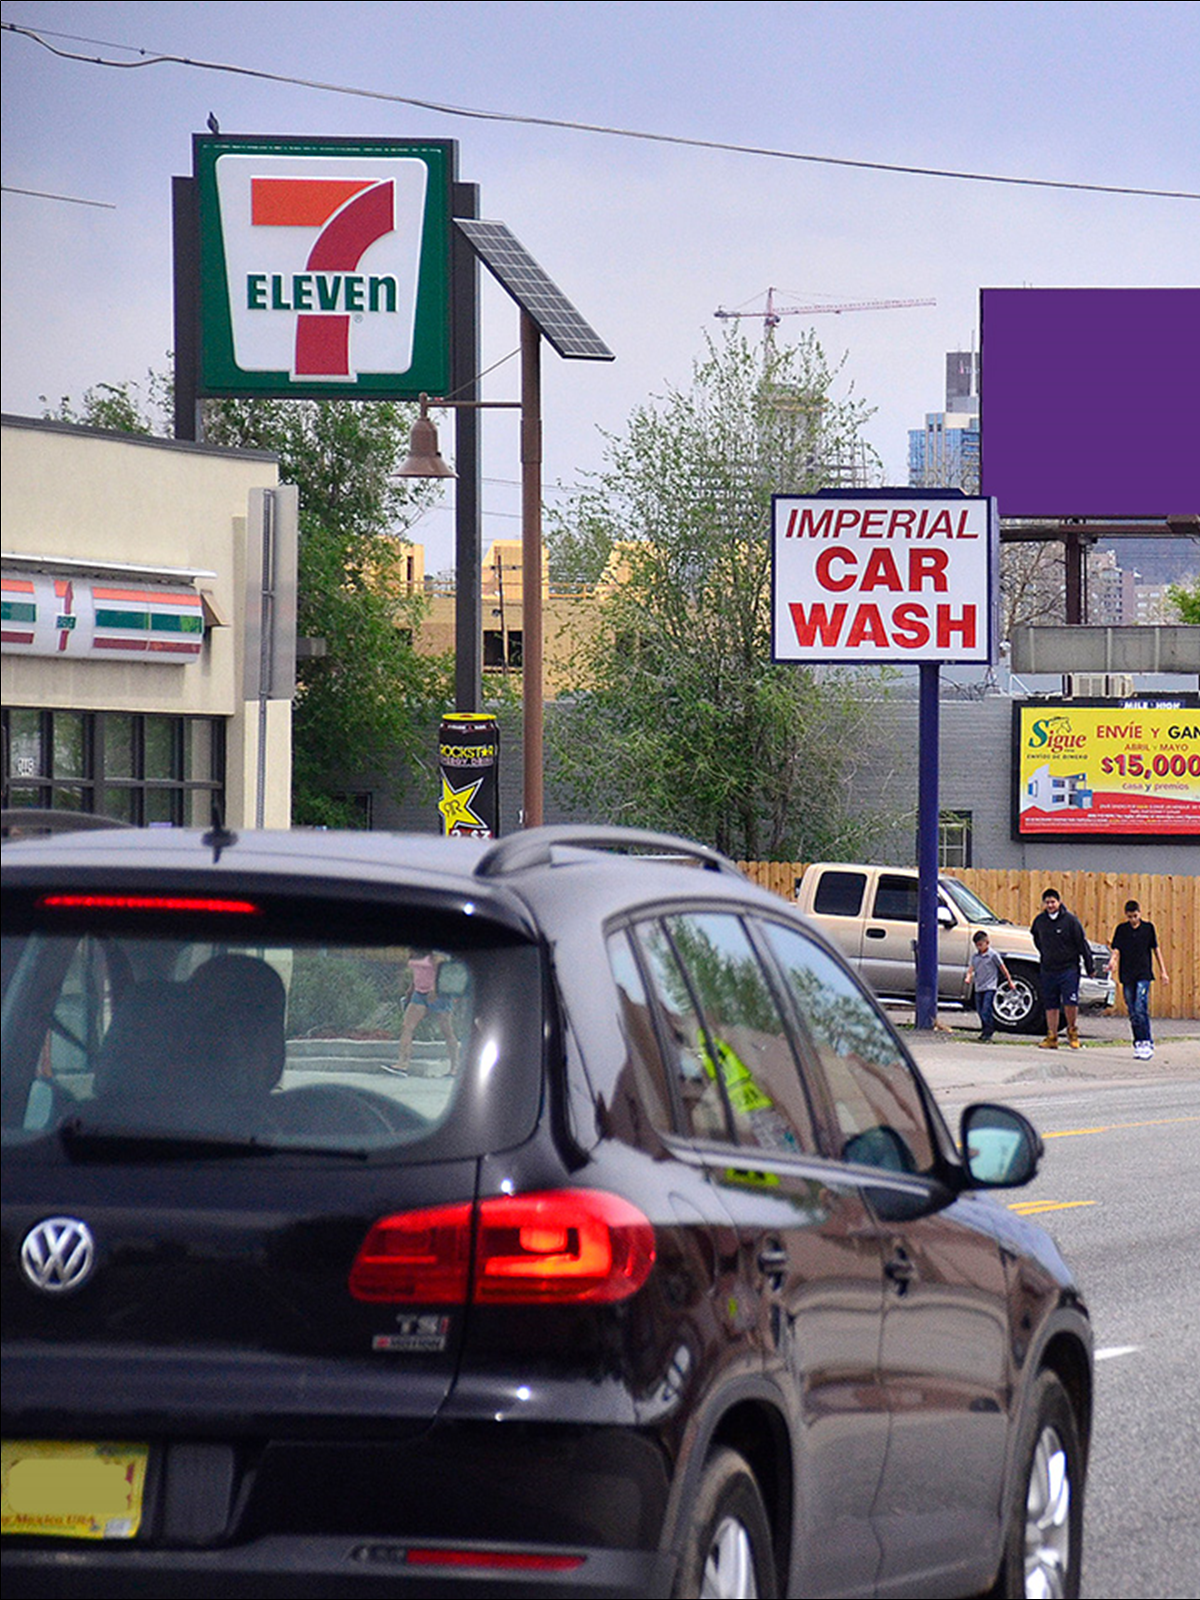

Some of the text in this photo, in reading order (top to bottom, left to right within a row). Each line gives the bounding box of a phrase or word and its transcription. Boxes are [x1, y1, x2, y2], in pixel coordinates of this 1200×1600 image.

[250, 176, 395, 376] 7
[785, 508, 979, 539] IMPERIAL
[815, 545, 949, 593] CAR
[788, 602, 977, 649] WASH
[1028, 719, 1087, 753] Sigue
[1096, 721, 1143, 739] ENVÍE
[1124, 743, 1150, 751] ABRIL
[1159, 743, 1189, 752] MAYO
[16, 1514, 63, 1525] Mexico
